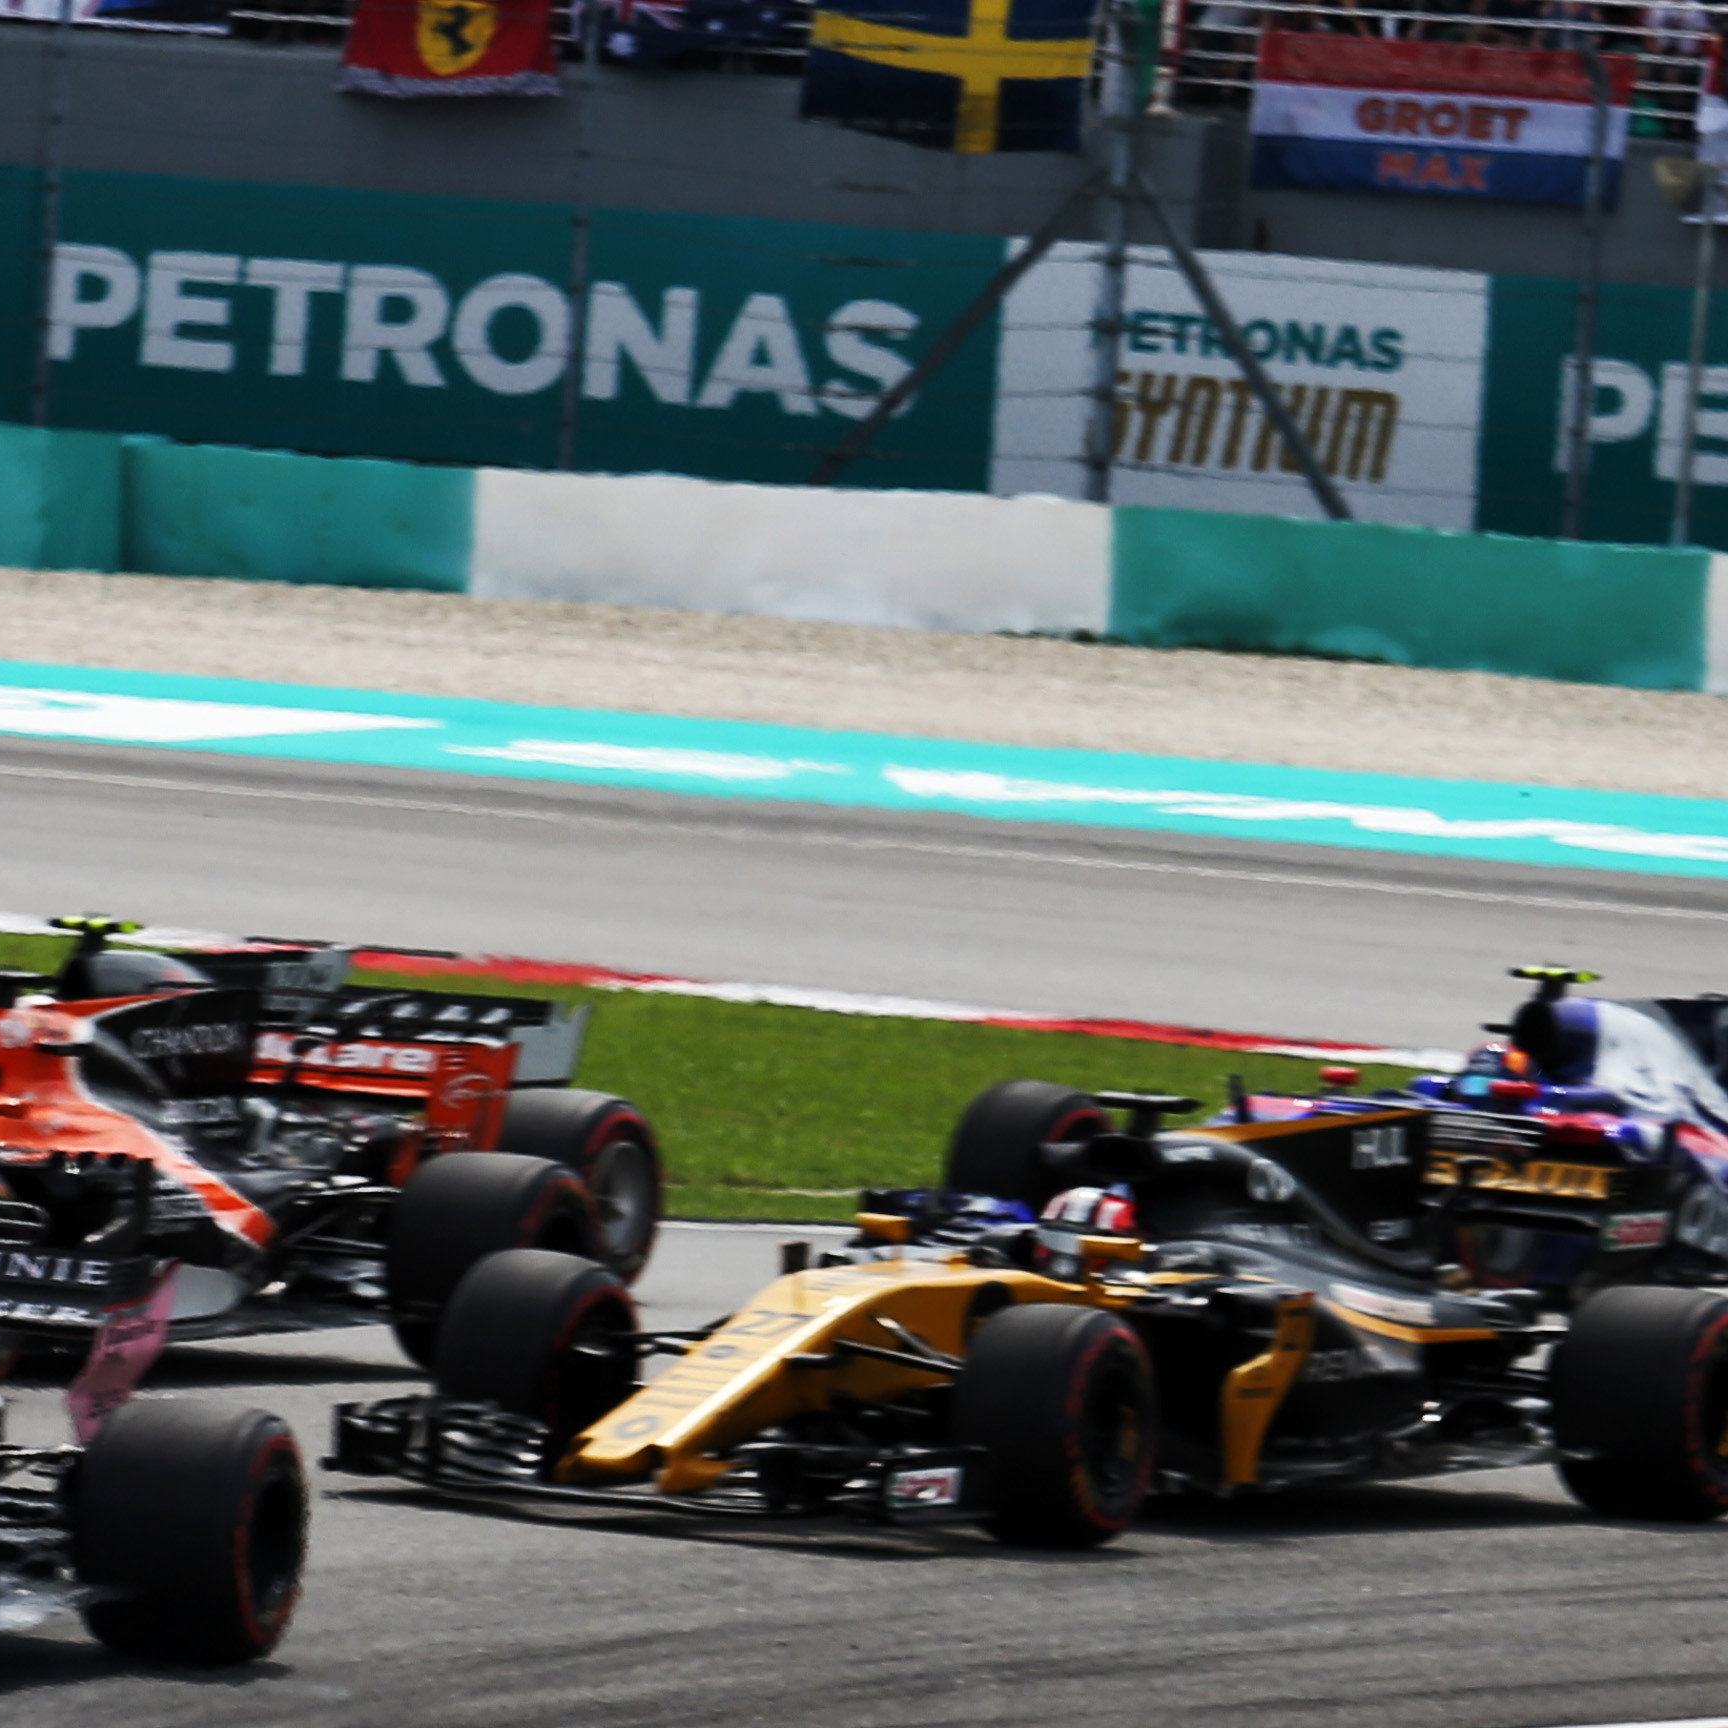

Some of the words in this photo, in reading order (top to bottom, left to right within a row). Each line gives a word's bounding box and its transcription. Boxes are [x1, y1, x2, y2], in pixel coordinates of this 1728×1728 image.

[1355, 97, 1530, 141] GROET
[1375, 150, 1492, 190] MAX
[48, 243, 922, 421] PETRONAS
